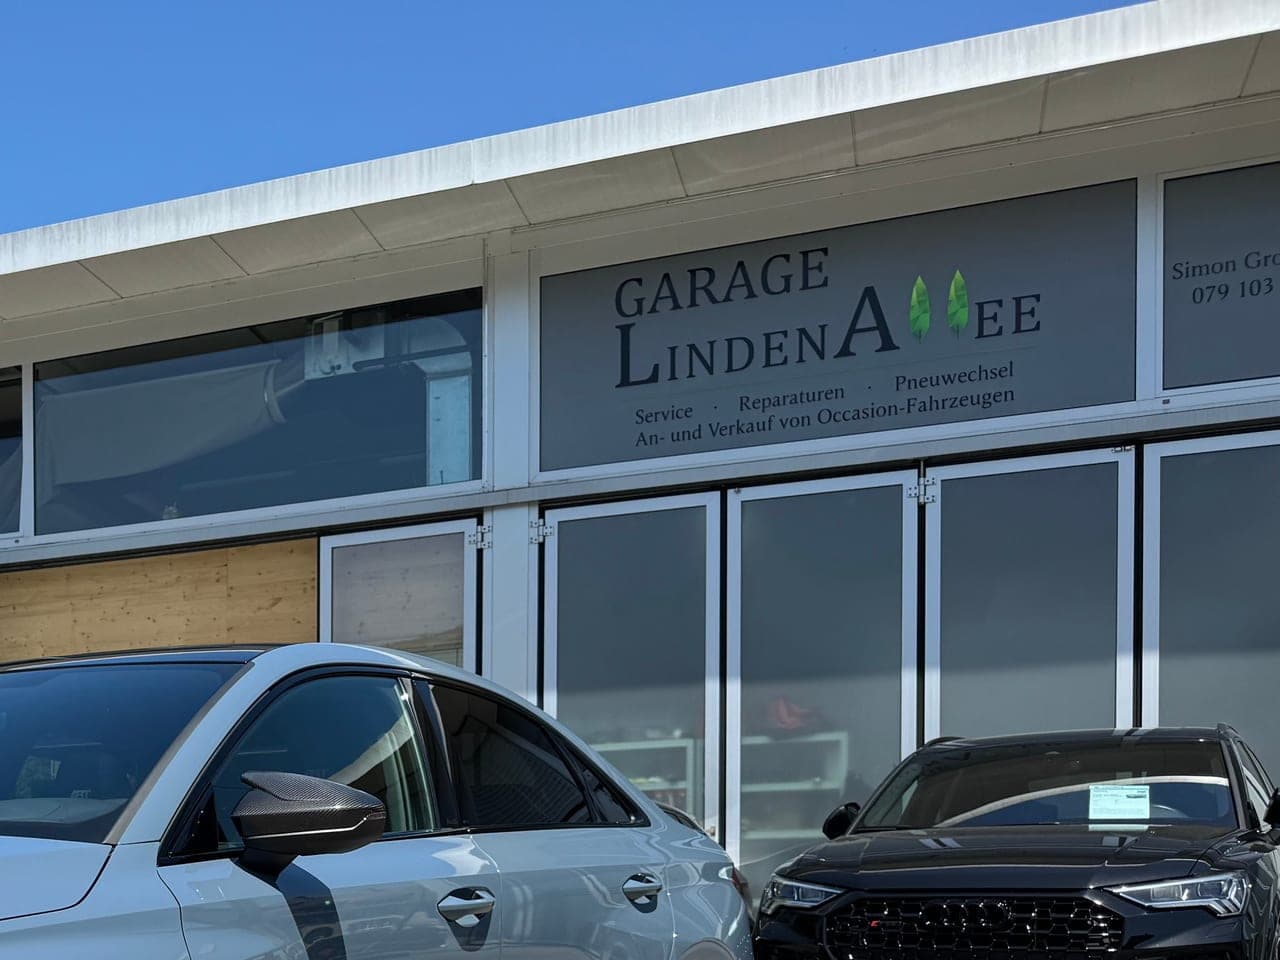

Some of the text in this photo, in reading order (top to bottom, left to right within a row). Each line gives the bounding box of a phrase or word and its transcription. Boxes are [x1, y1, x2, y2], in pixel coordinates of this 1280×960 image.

[615, 247, 829, 318] GARAGE
[1172, 260, 1236, 280] Simon
[1192, 277, 1273, 304] 079 103
[635, 360, 1014, 425] Service Reparaturen Pneuwechsel
[635, 389, 1015, 447] An- und Verkauf von Occasion-Fahrzeugen
